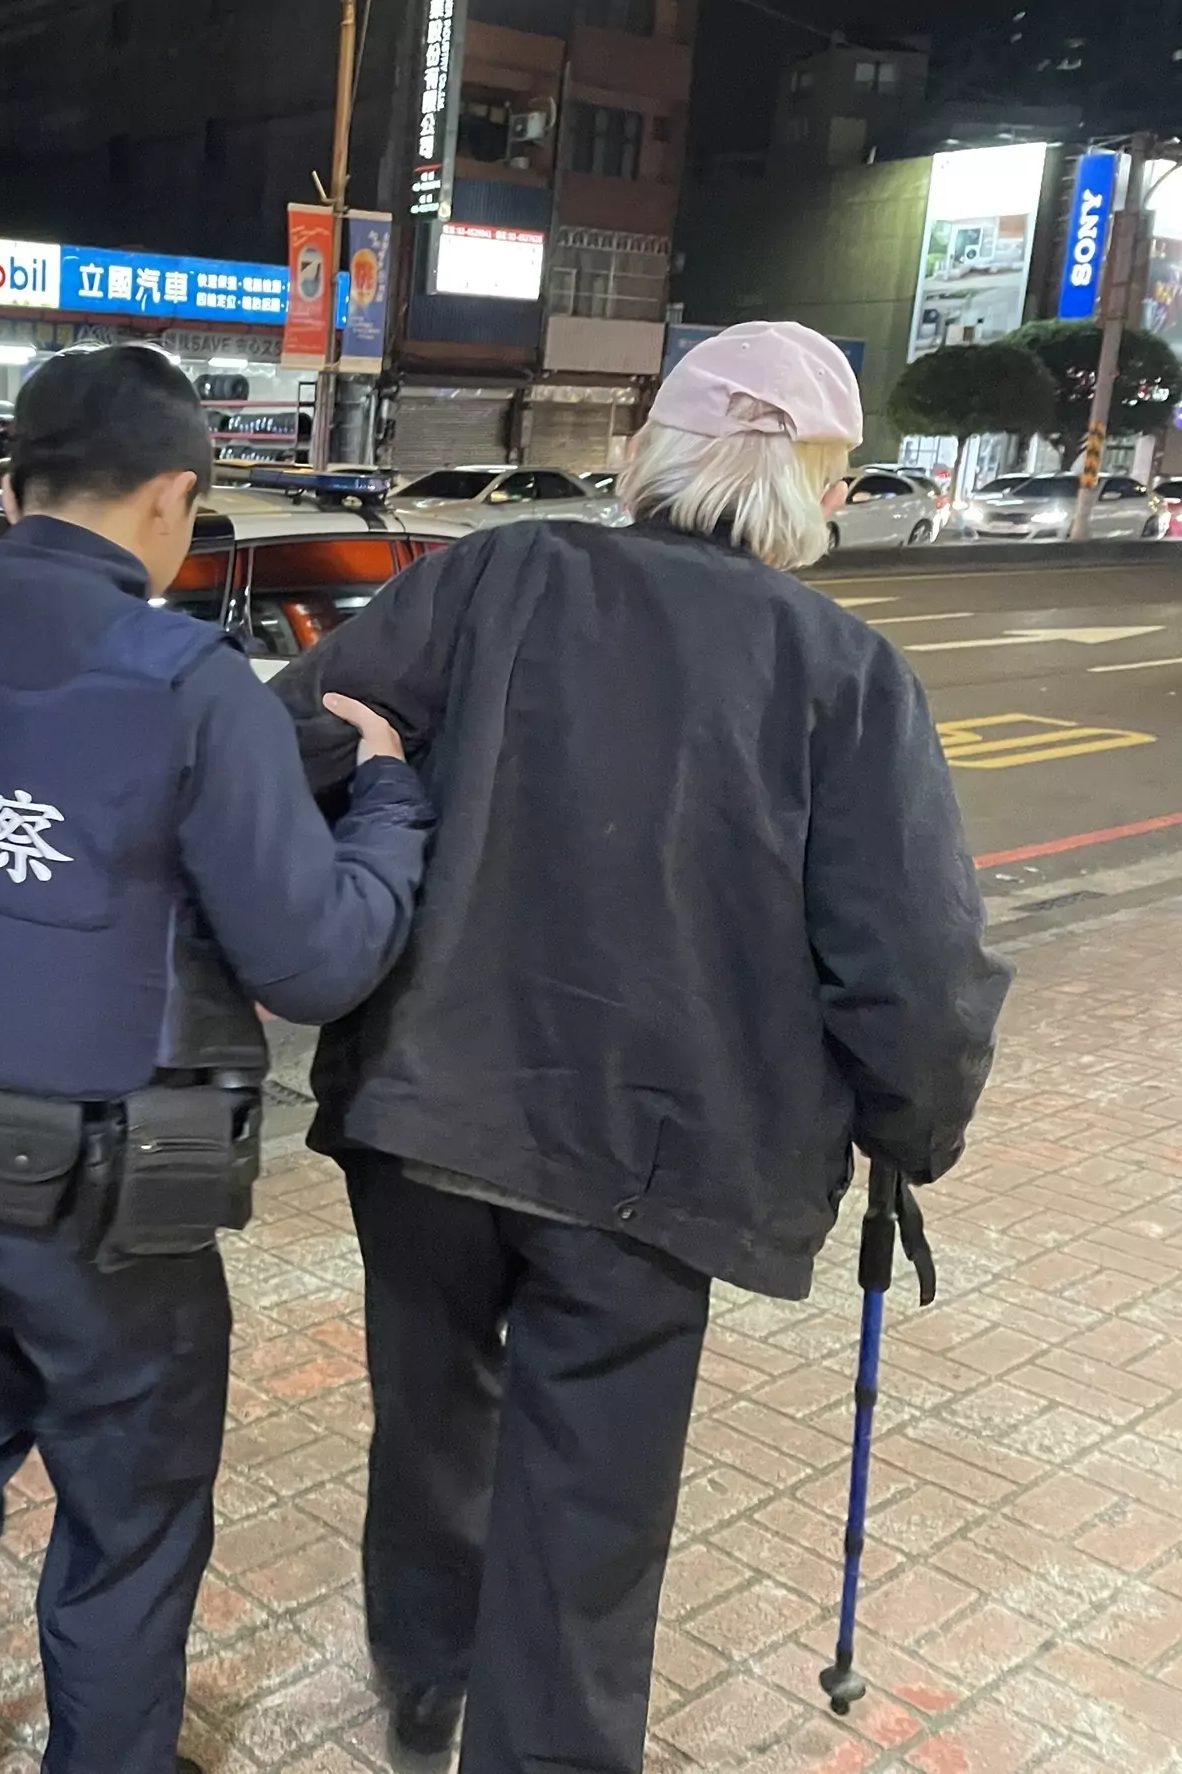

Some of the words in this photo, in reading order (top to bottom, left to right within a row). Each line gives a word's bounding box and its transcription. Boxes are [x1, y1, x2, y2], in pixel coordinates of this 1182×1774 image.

[1070, 188, 1103, 286] SONY
[78, 262, 189, 310] 立國汽車
